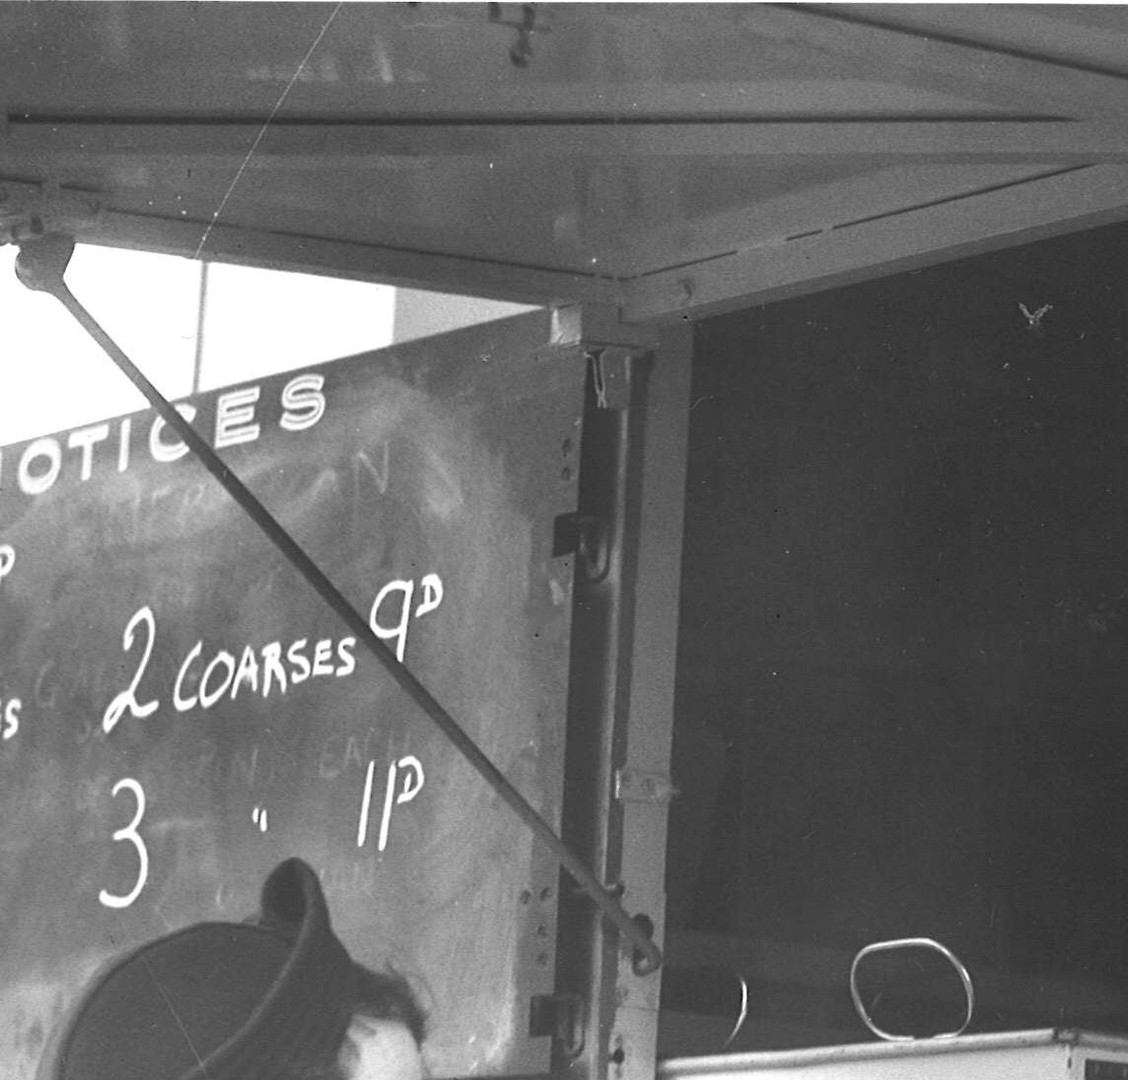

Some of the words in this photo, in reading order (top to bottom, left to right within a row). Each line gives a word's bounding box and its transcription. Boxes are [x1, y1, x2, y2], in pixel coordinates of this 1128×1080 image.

[0, 373, 326, 495] OTICES
[0, 698, 22, 740] S
[102, 606, 159, 733] 2
[172, 636, 357, 711] COARSES
[100, 778, 149, 908] 3
